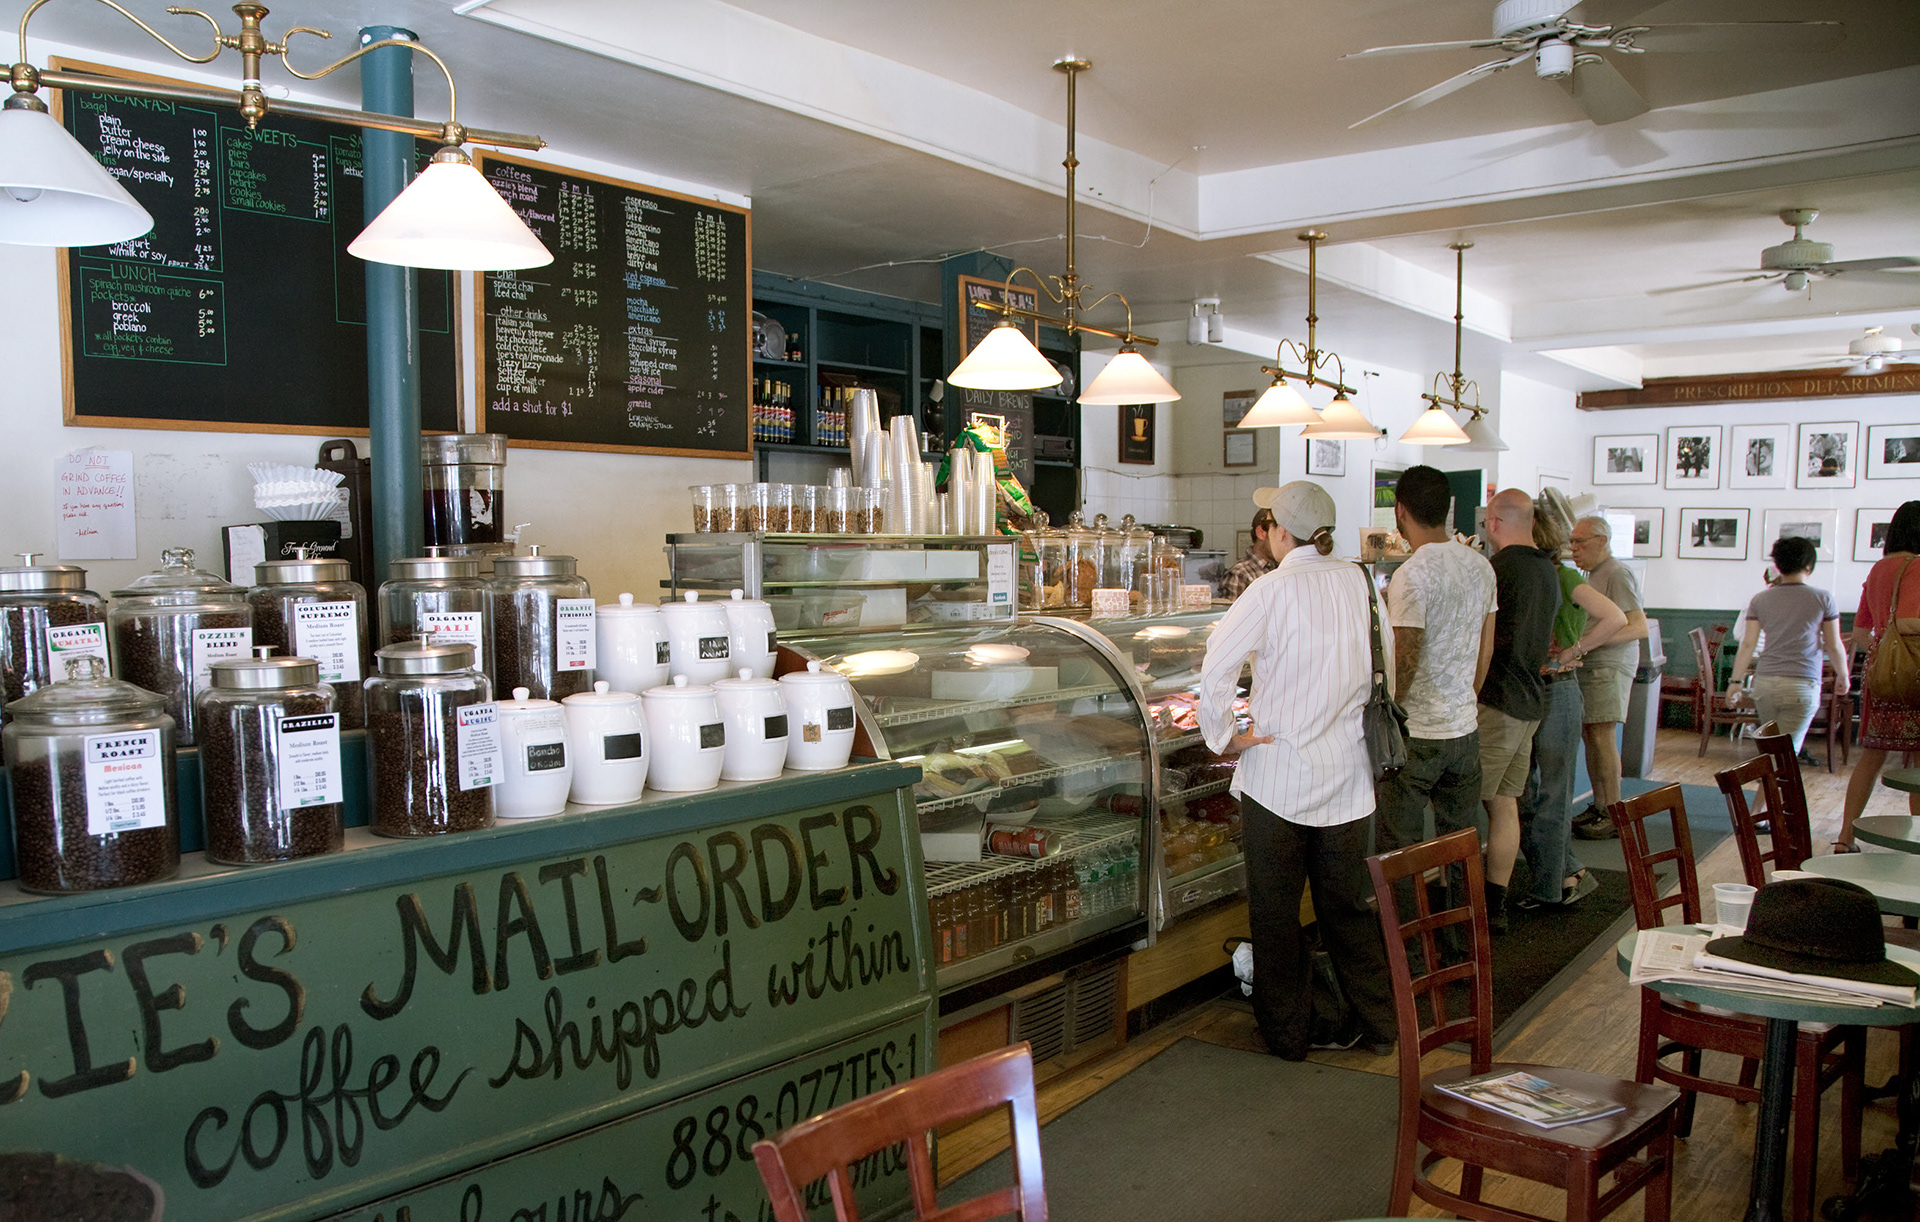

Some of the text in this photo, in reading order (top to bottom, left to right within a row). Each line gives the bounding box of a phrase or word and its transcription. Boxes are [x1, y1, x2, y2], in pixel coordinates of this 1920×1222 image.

[80, 97, 107, 115] bagel
[98, 112, 122, 126] plain
[100, 124, 132, 138] butter
[244, 126, 297, 148] SWEETS
[100, 134, 165, 153] cream cheese
[102, 145, 122, 158] jelly
[134, 149, 150, 160] the
[153, 152, 170, 163] side
[228, 148, 248, 160] pies
[230, 158, 250, 169] bars
[229, 168, 267, 181] cupcakes
[343, 165, 364, 178] lettuc
[495, 166, 532, 183] coffees
[229, 176, 257, 189] hearts
[518, 184, 538, 196] blend
[519, 192, 538, 203] roast
[625, 196, 658, 210] espresso
[231, 196, 287, 213] small cookies
[625, 212, 642, 222] latte
[625, 220, 661, 234] cappuccino
[625, 228, 647, 239] mocha
[625, 235, 659, 248] americano
[626, 243, 660, 256] macchiato
[139, 251, 148, 259] or
[152, 251, 167, 265] soy
[627, 259, 645, 272] dirty
[110, 263, 157, 283] LUNCH
[640, 273, 666, 286] espresso
[124, 282, 192, 300] mushroom quiche
[494, 279, 534, 293] spiced chai
[494, 289, 527, 300] iced chai
[112, 300, 151, 313] broccoli
[626, 297, 648, 307] mocha
[500, 306, 548, 321] other drinks
[627, 304, 659, 316] macchiato
[112, 312, 139, 323] greek
[627, 312, 661, 323] americano
[113, 322, 147, 335] poblano
[519, 320, 534, 329] soda
[627, 323, 654, 336] extras
[496, 326, 525, 338] heavenly
[496, 333, 508, 342] hot
[146, 335, 172, 345] contain
[496, 342, 511, 351] cold
[145, 344, 174, 355] cheese
[628, 350, 640, 360] soy
[658, 346, 678, 359] syrup
[629, 359, 678, 371] whipped cream
[629, 366, 661, 376] cup of ice
[497, 366, 528, 379] seltzer
[498, 373, 525, 385] bottled
[629, 373, 662, 387] seasonal
[496, 382, 538, 396] cup of milk
[627, 384, 646, 394] apple
[1675, 381, 1793, 399] PRESCRIPTION
[965, 388, 1029, 409] DAILY BREWS
[492, 397, 573, 417] add a shot for $1
[627, 399, 652, 412] granita
[69, 454, 109, 466] DO NOT
[1011, 459, 1028, 472] OAST
[60, 472, 126, 484] GRIND COFFEE
[62, 484, 125, 498] IN ADVANCE!!
[299, 604, 350, 612] COLUMBIAN
[52, 628, 99, 639] ORGANIC
[433, 624, 470, 632] BALI
[199, 631, 245, 640] OZZIE'S
[53, 637, 100, 648] SUMATRA
[206, 641, 238, 649] BLEND
[463, 707, 493, 717] UGANDA
[283, 718, 334, 729] BRAZILIAN
[96, 738, 147, 750] FRENCH
[101, 748, 144, 759] ROAST
[103, 763, 142, 772] Mexican
[184, 908, 911, 1190] coffee shipped within
